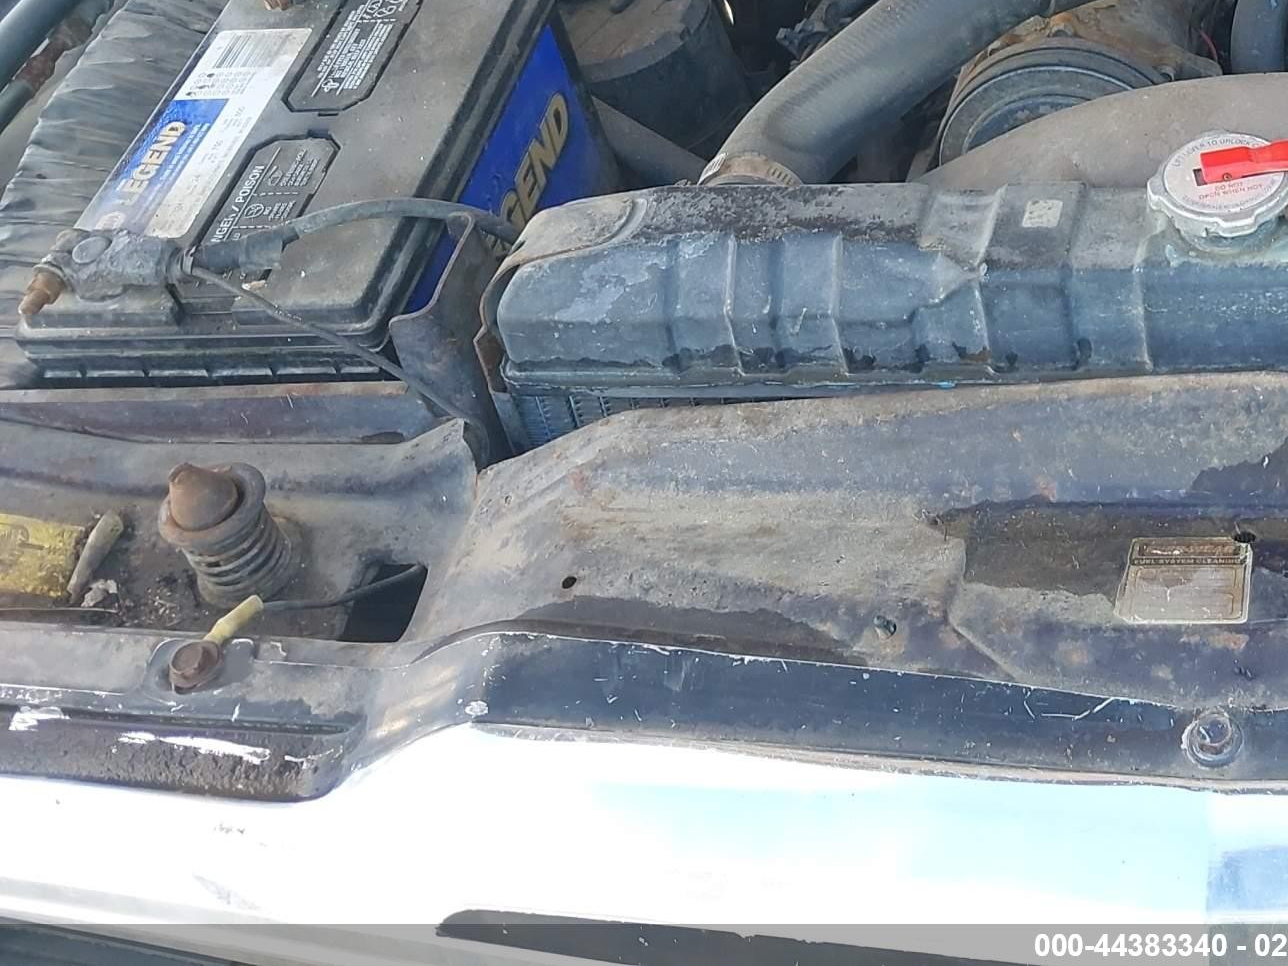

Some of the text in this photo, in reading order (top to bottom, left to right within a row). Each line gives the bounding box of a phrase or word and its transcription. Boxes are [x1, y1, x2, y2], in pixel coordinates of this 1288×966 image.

[118, 120, 187, 207] LEGEND
[234, 165, 266, 203] POISON
[483, 91, 569, 249] GEND
[1133, 557, 1157, 565] FUEL
[1195, 557, 1241, 565] CLEANING
